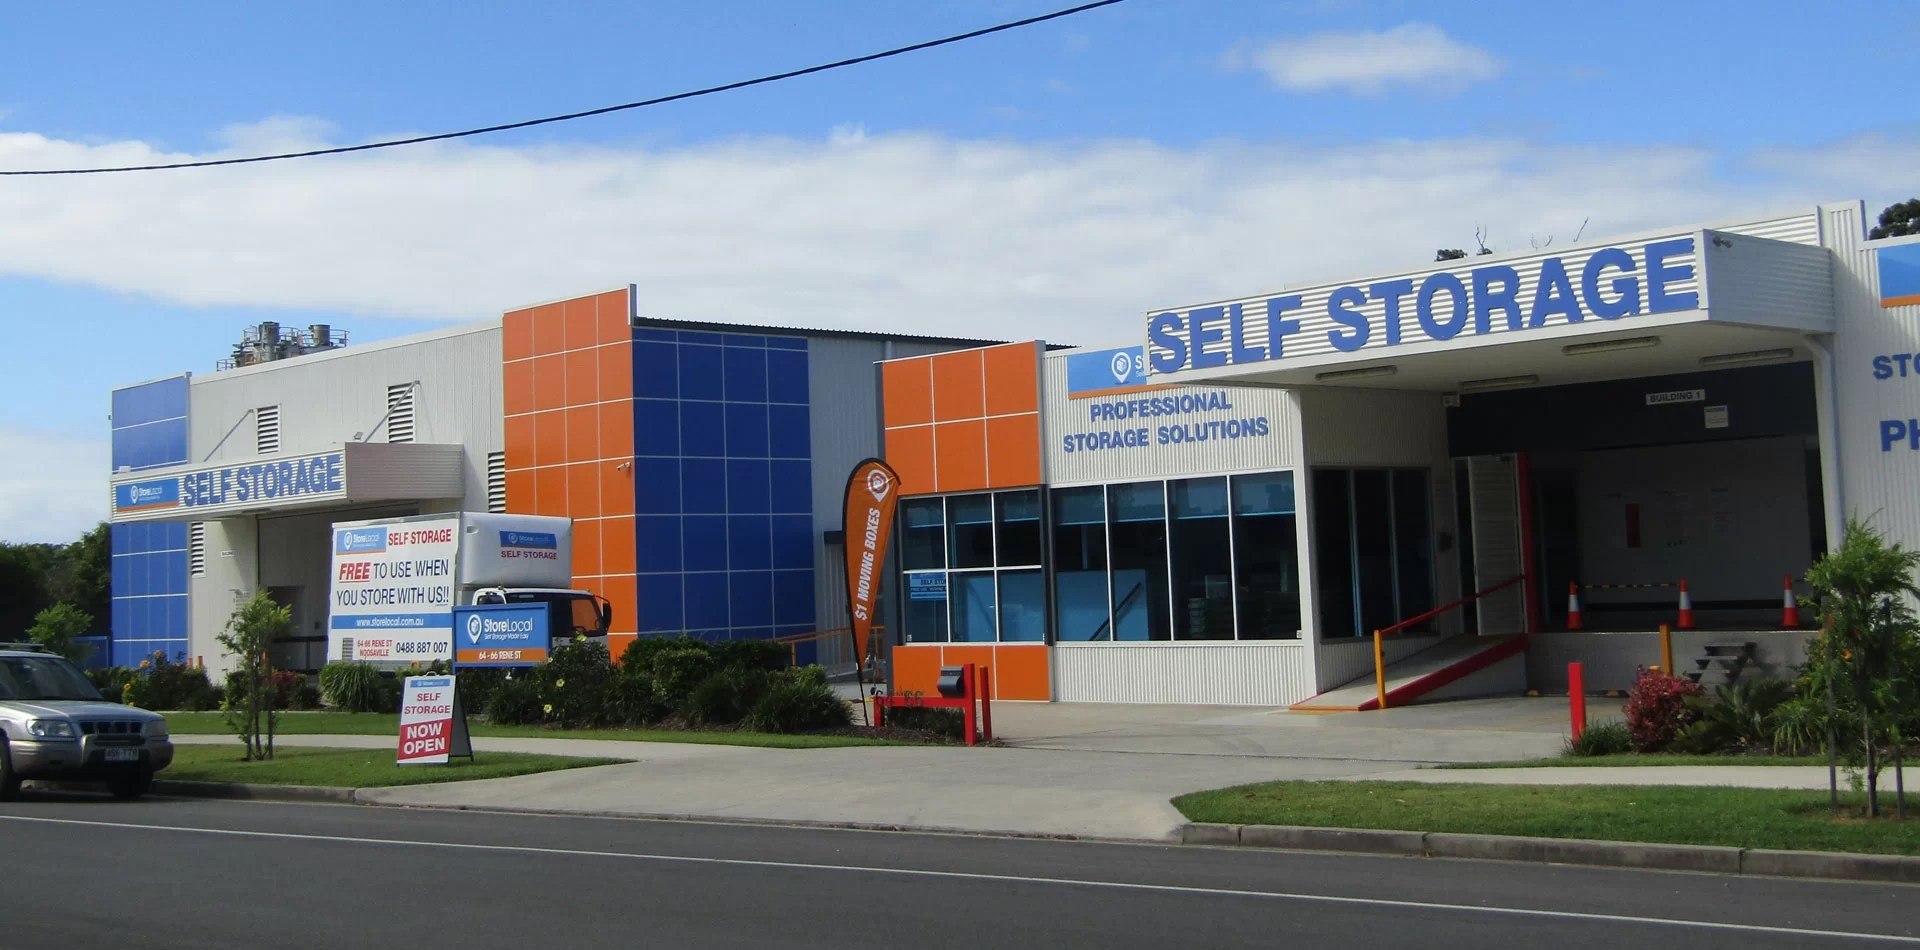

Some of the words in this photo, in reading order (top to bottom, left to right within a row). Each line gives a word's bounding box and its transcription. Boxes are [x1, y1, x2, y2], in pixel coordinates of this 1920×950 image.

[1149, 295, 1302, 374] SELF
[1327, 238, 1698, 352] STORAGE
[1650, 392, 1693, 402] BUILDING
[1090, 391, 1232, 422] PROFESSIONAL
[1063, 428, 1149, 453] STORAGE
[1158, 417, 1268, 445] SOLUTIONS
[183, 469, 232, 507] SELF
[236, 454, 341, 501] STORAGE
[864, 507, 881, 550] BOXES
[388, 532, 409, 546] SELF
[411, 529, 452, 545] STORAGE
[523, 551, 557, 559] STORAGE
[339, 562, 371, 580] FREE
[373, 563, 388, 579] TO
[390, 561, 412, 579] USE
[415, 559, 449, 576] WHEN
[857, 551, 874, 601] MOVING
[336, 590, 358, 606] YOU
[360, 588, 395, 606] STORE
[397, 587, 425, 604] WITH
[427, 586, 449, 604] US!!
[854, 603, 867, 621] $1
[356, 617, 424, 627] www.storelocal.com.au
[484, 618, 533, 632] StoreLocal
[396, 642, 414, 653] 0488
[416, 642, 431, 653] 887
[433, 642, 448, 653] 007
[479, 651, 487, 660] 64
[490, 651, 498, 660] 66
[499, 651, 514, 659] RENE
[515, 650, 521, 659] ST
[416, 692, 441, 702] SELF
[404, 705, 451, 715] STORAGE
[407, 722, 443, 739] NOW
[403, 737, 445, 755] OPEN
